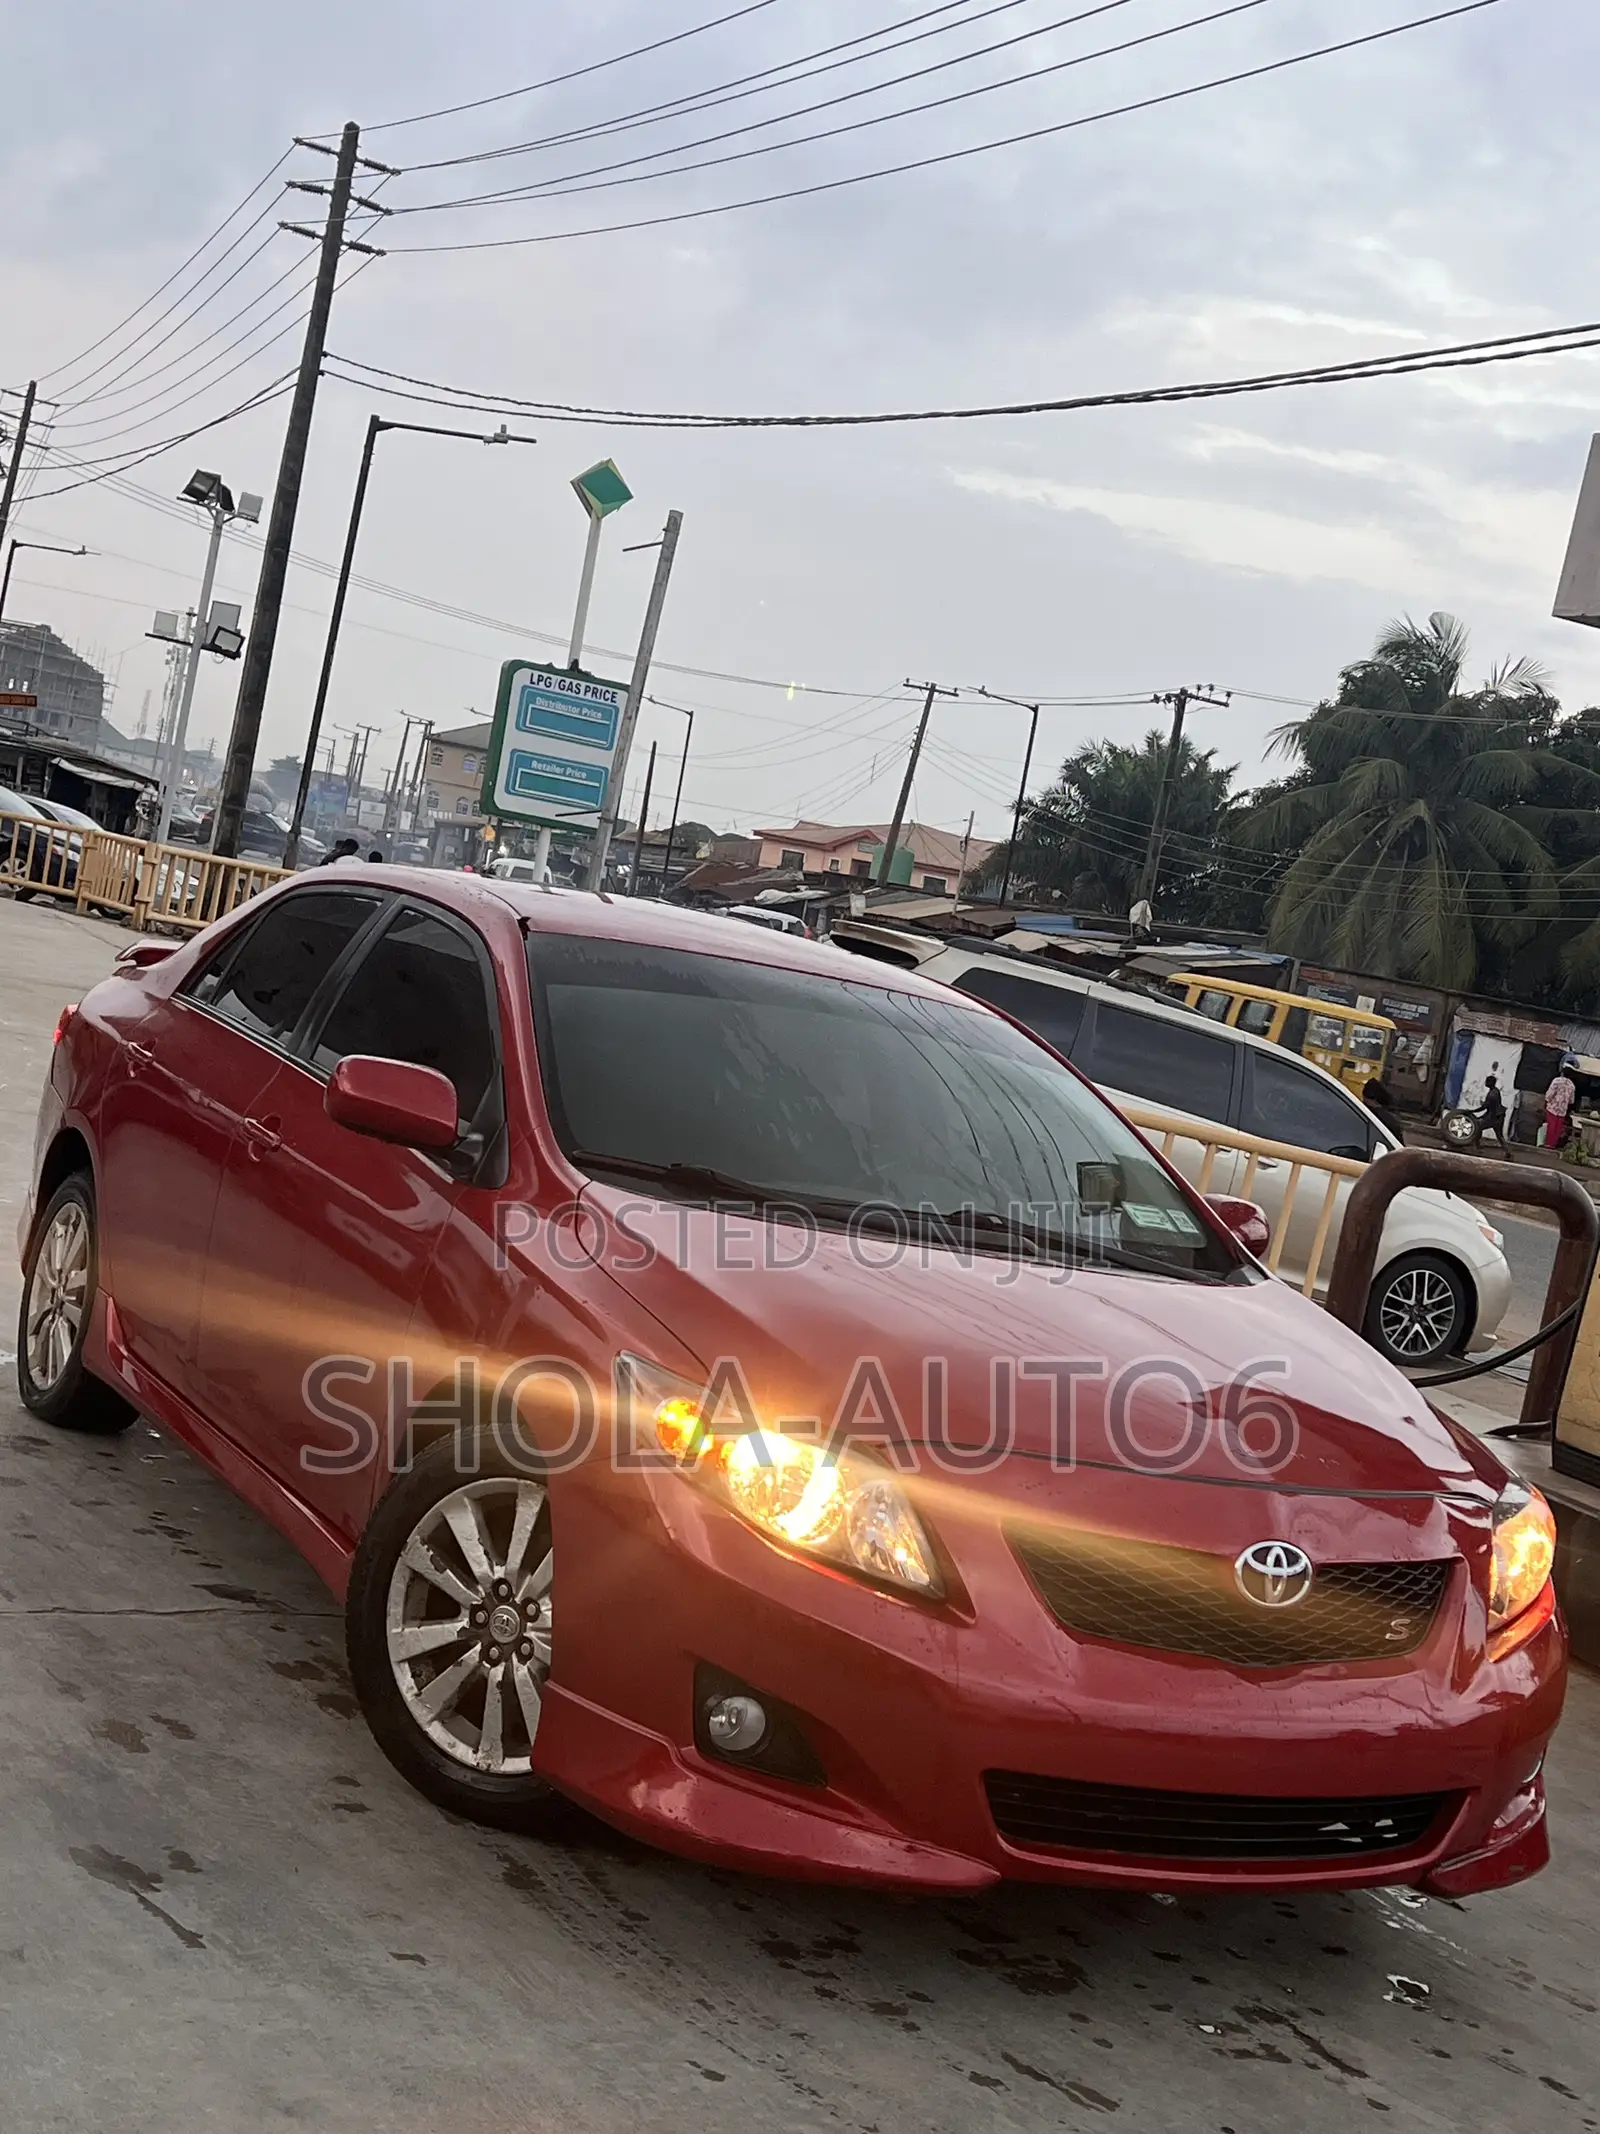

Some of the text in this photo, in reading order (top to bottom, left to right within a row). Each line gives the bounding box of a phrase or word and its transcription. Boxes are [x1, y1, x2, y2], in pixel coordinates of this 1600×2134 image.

[583, 685, 618, 704] PRICE
[535, 697, 603, 719] Distributor Price
[531, 760, 587, 780] Retailer Price
[1385, 1618, 1411, 1640] S
